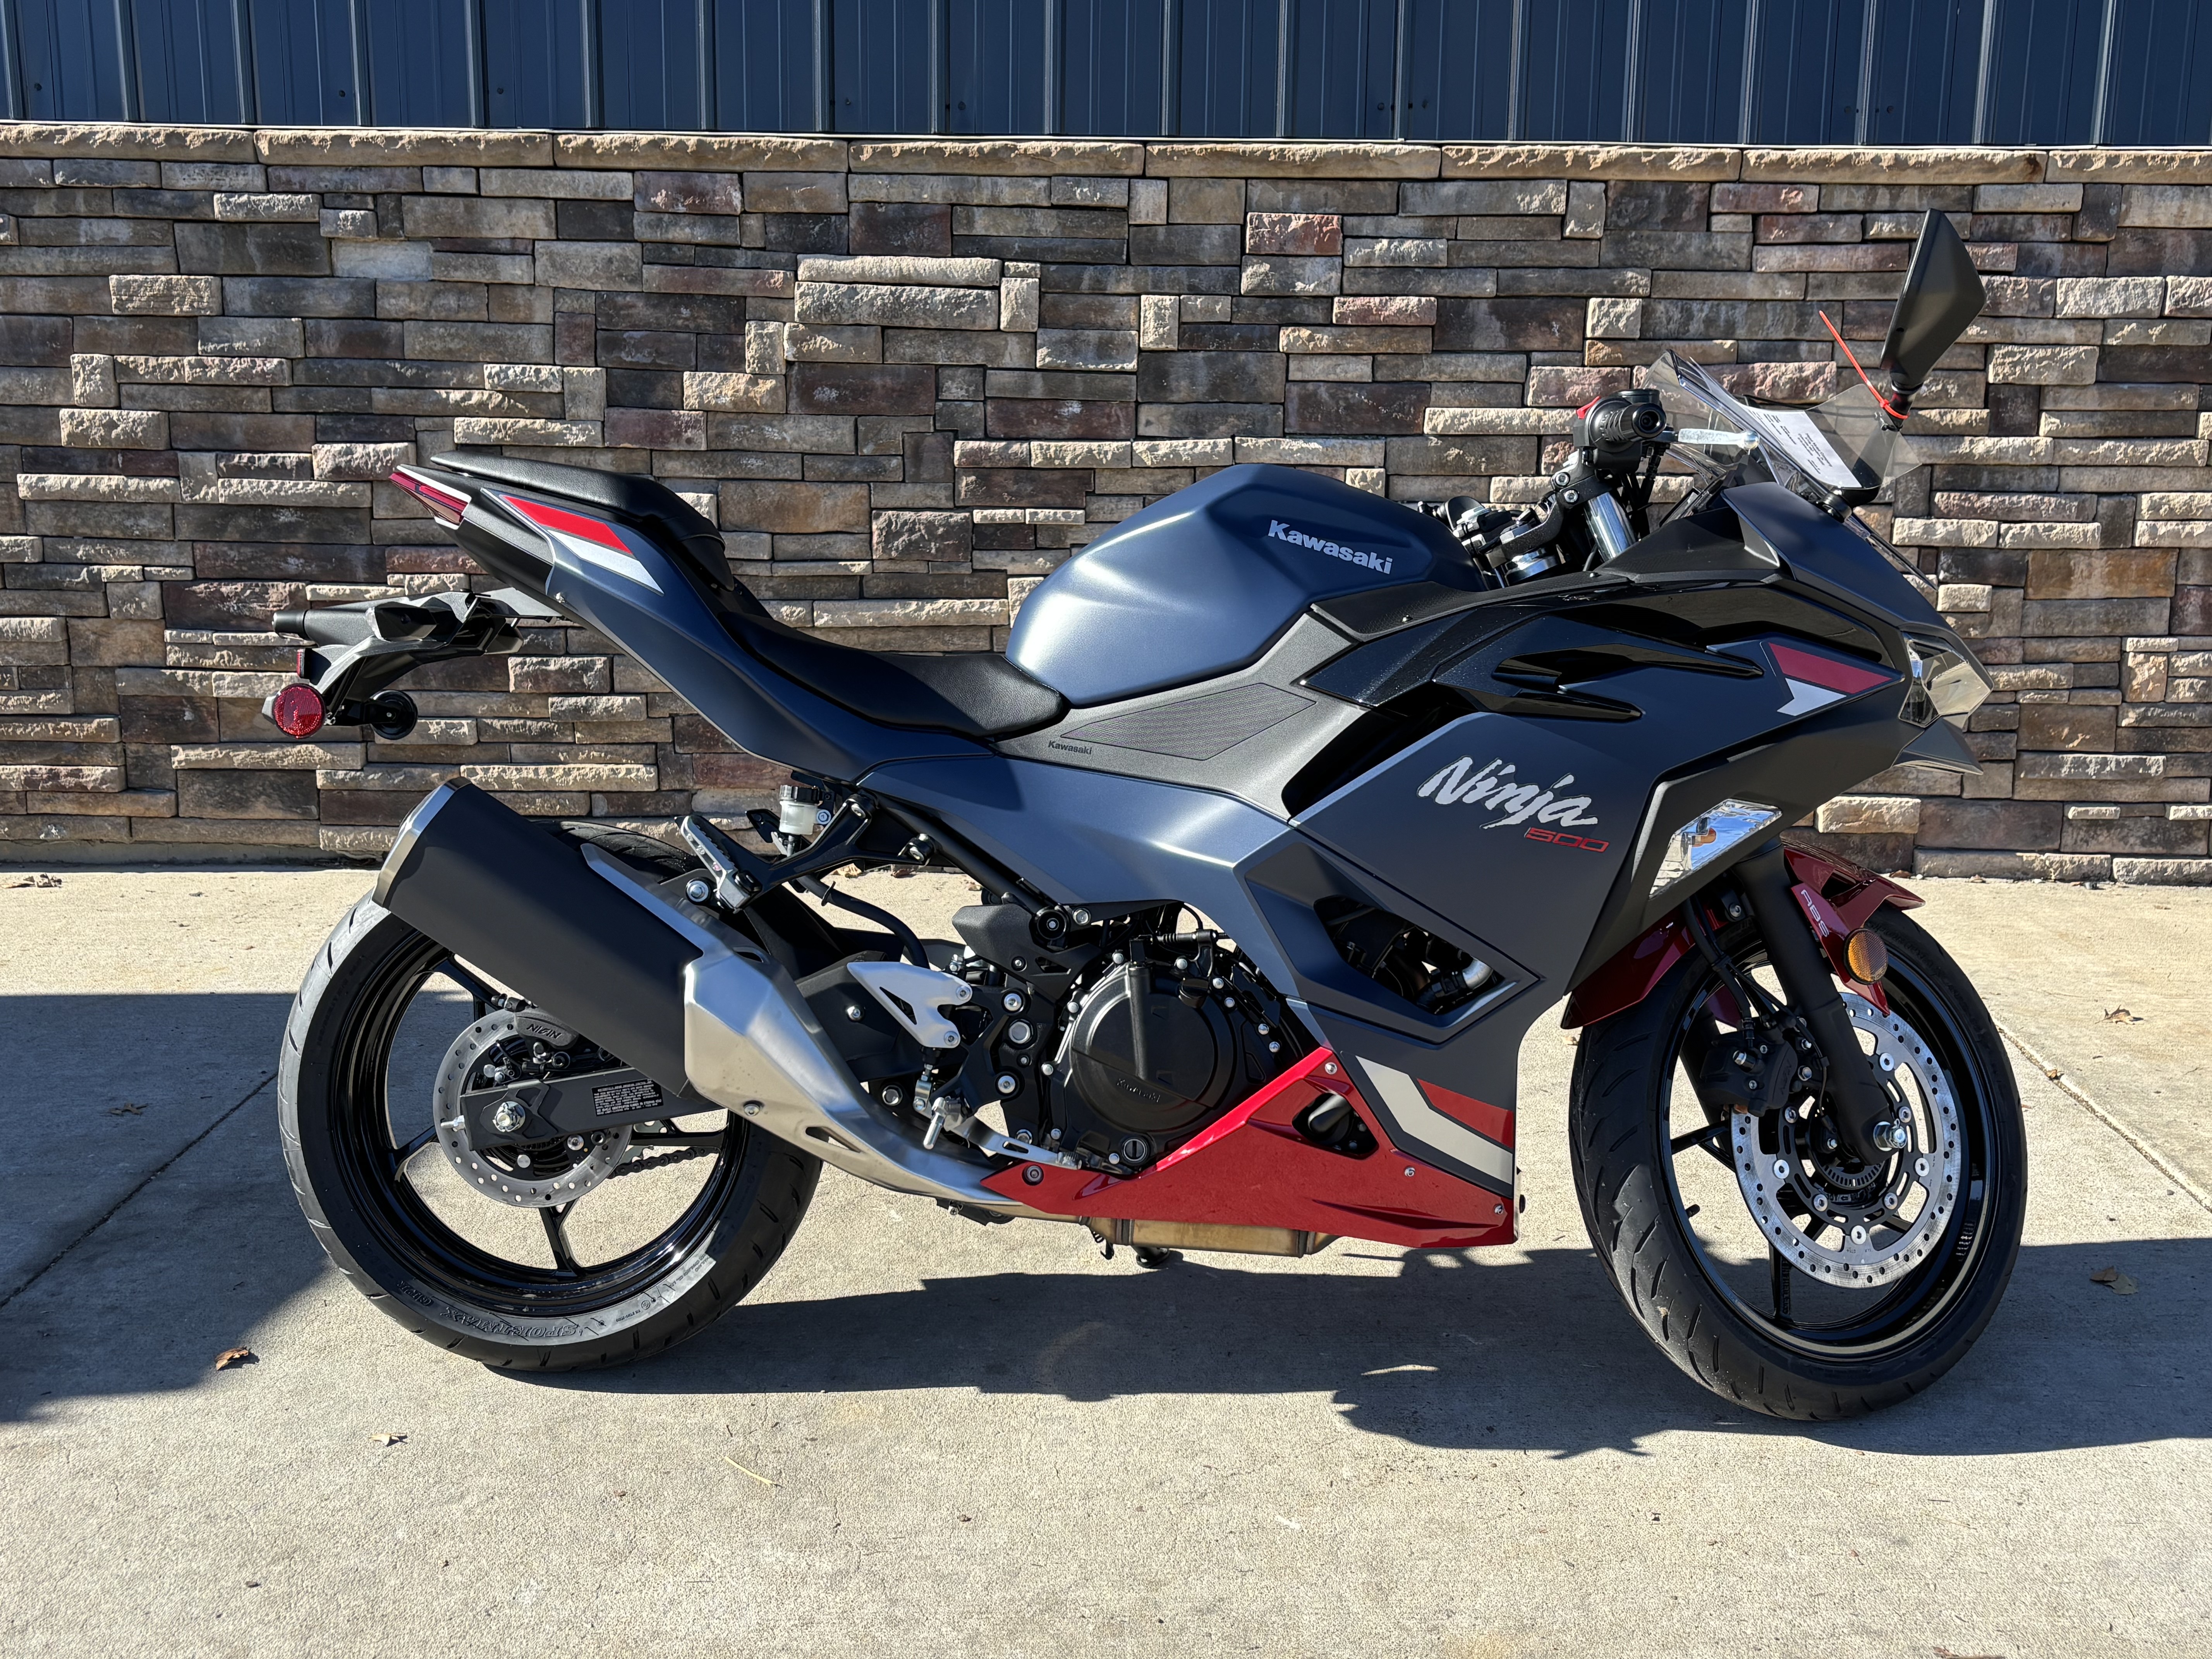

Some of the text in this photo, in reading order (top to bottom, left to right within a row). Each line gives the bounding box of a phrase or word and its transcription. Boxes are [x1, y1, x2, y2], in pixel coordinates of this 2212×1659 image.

[1267, 520, 1393, 574] Kawasaki
[1048, 740, 1092, 755] Kawasaki
[1417, 756, 1599, 830] Ninja
[1524, 827, 1610, 852] 500
[1801, 889, 1829, 937] ABS
[440, 1306, 579, 1337] SPORTMAX
